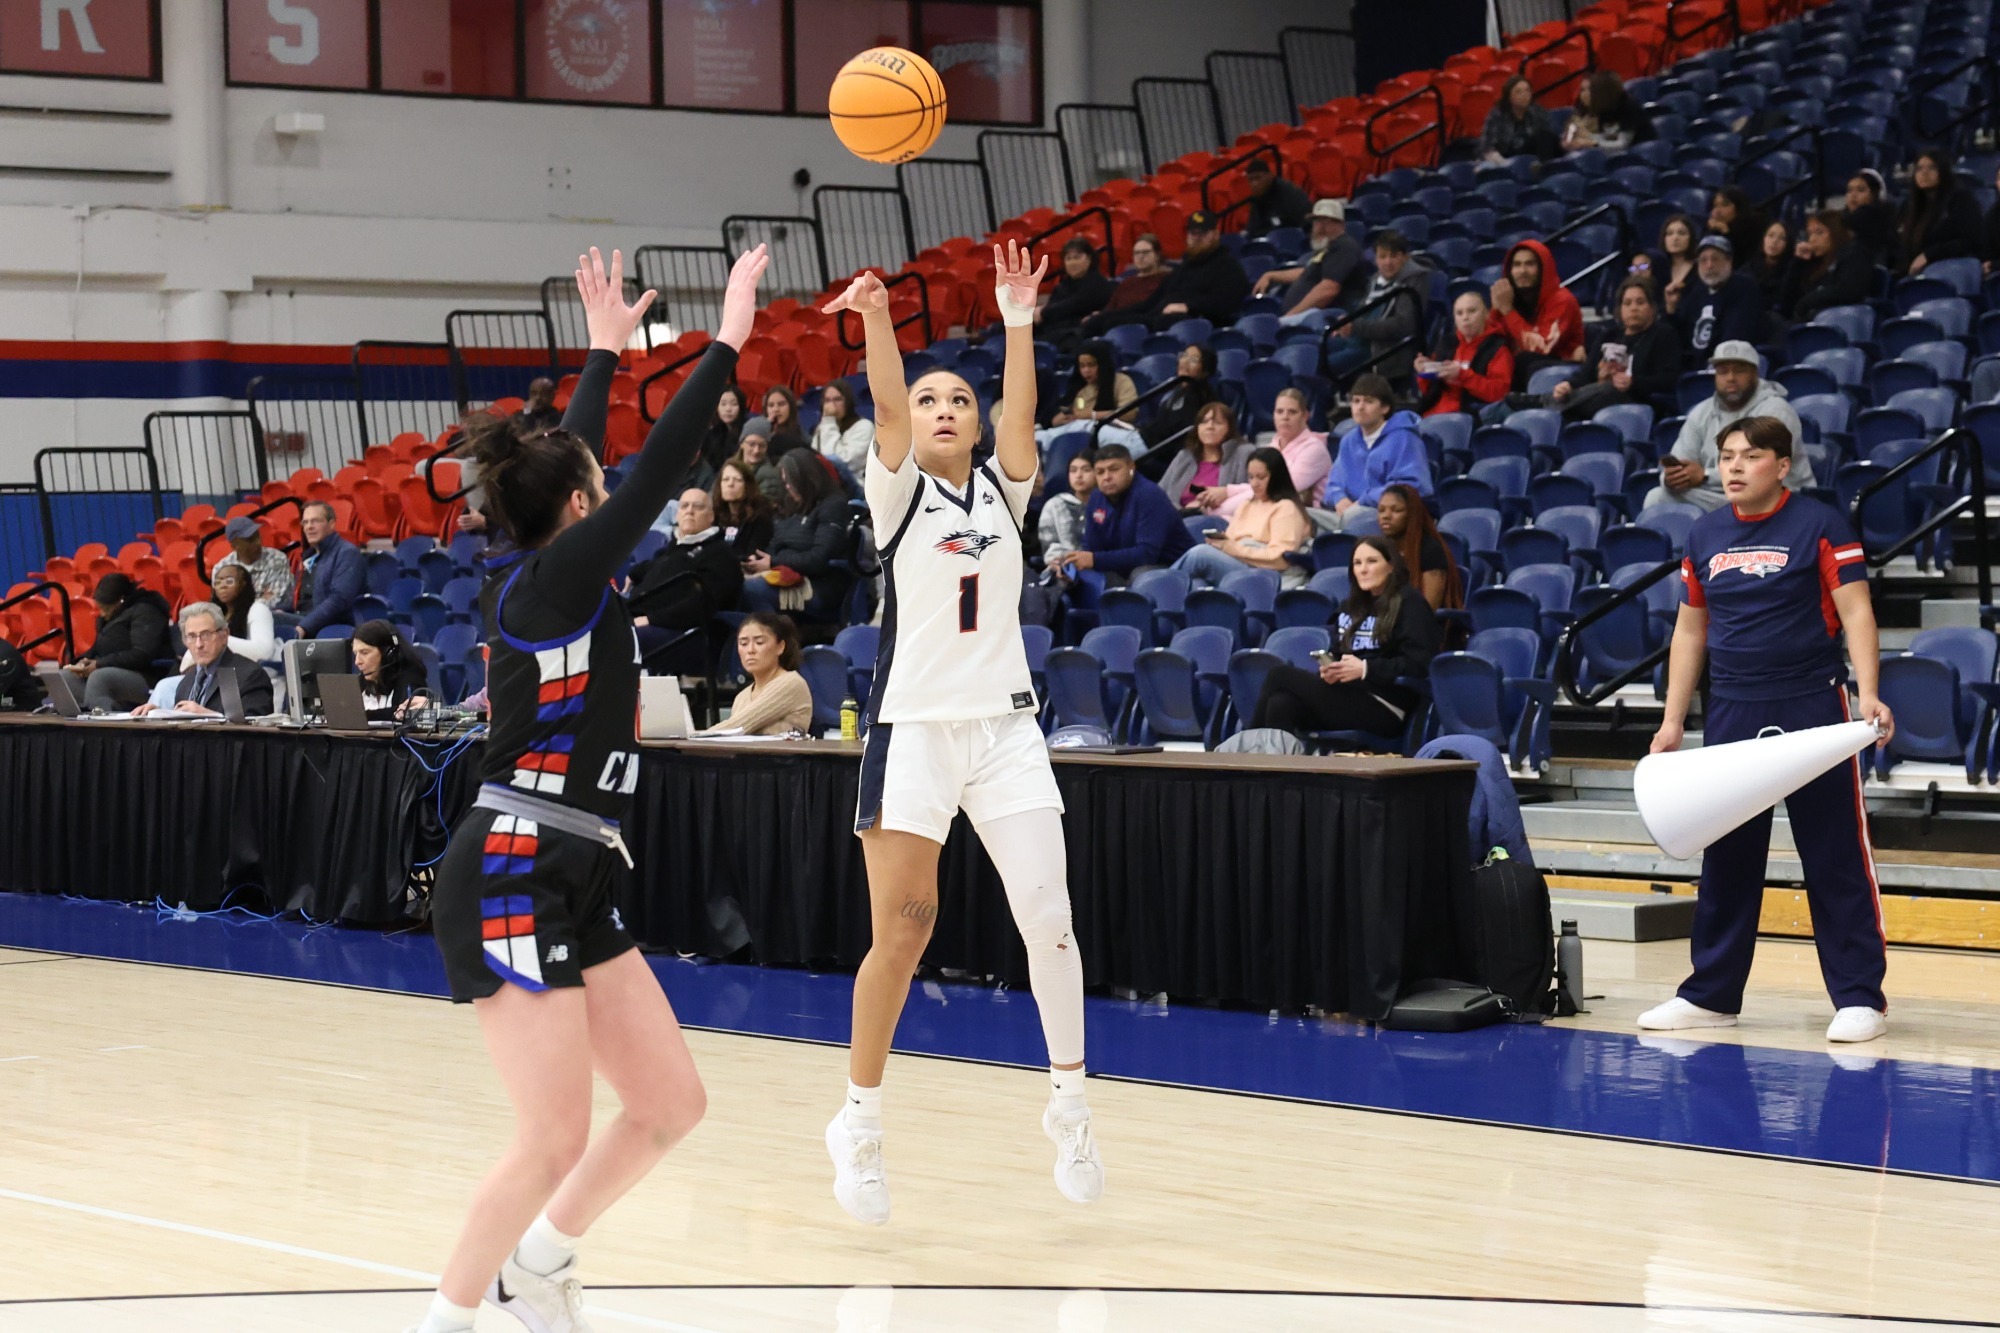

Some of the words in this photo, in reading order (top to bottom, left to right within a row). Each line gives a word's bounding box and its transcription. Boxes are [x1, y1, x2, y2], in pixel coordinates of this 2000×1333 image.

[268, 0, 320, 65] S
[1711, 552, 1787, 577] ROADRUNNERS
[959, 572, 980, 634] 1
